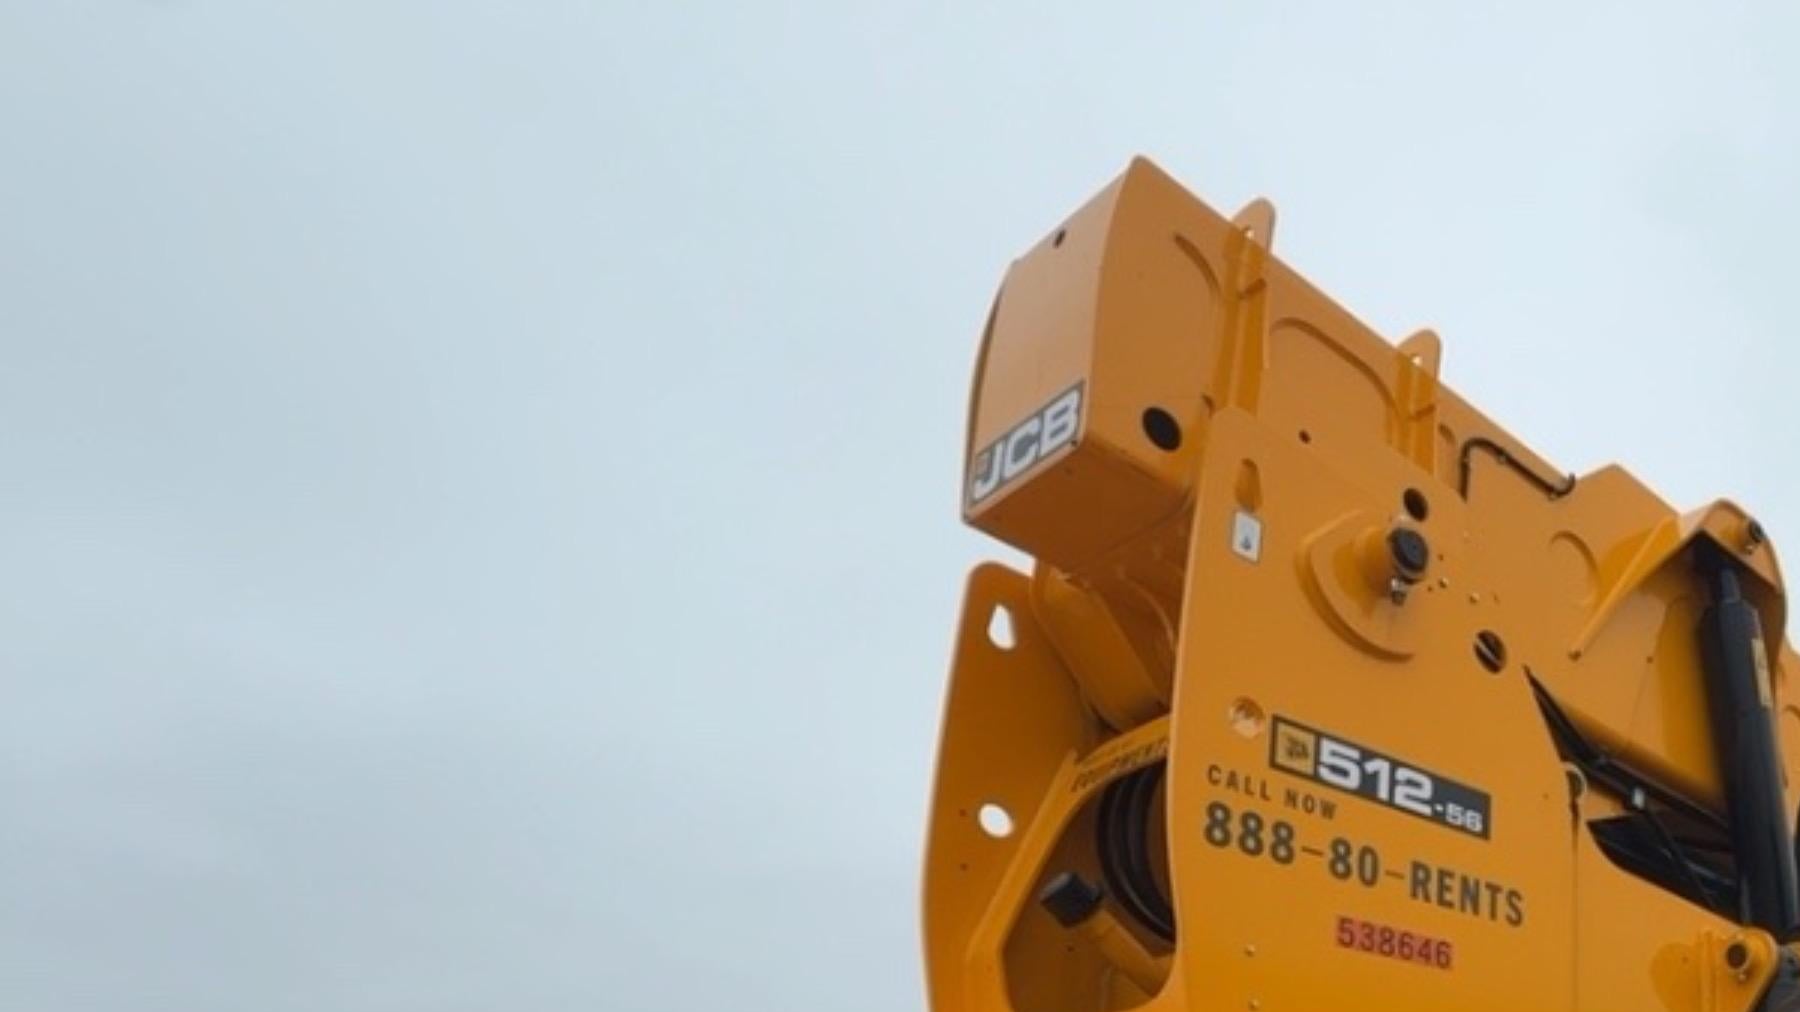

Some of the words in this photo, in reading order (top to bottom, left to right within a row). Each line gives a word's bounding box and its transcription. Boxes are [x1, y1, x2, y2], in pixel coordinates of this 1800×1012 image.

[972, 388, 1082, 502] JCB
[1207, 764, 1271, 801] CALL
[1284, 789, 1337, 820] NOW
[1204, 800, 1524, 928] 888-80-RENTS
[1336, 916, 1453, 970] 538646
